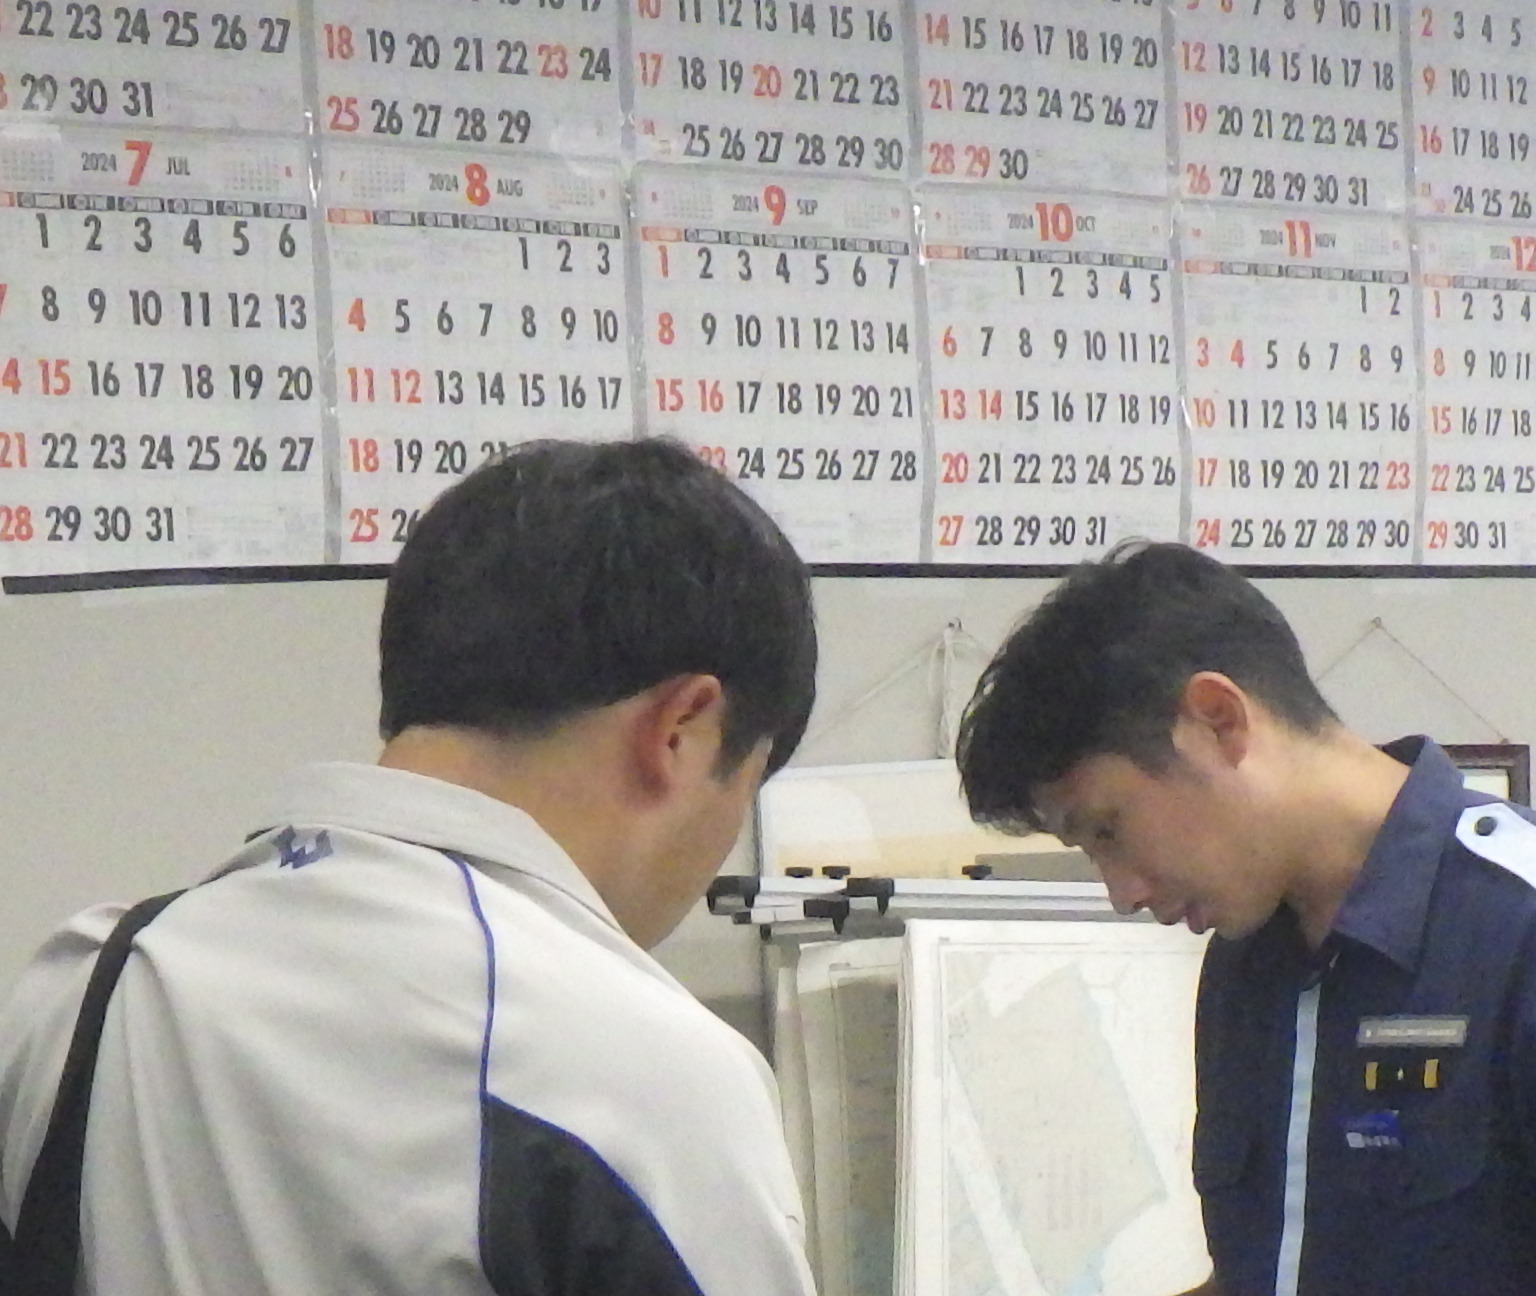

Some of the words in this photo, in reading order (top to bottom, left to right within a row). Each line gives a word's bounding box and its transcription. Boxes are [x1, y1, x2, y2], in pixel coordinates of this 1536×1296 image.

[324, 23, 354, 61] 18
[365, 27, 397, 65] 19
[405, 31, 442, 71] 20
[452, 35, 485, 73] 21
[495, 38, 530, 77] 22
[537, 43, 569, 80] 23
[577, 45, 613, 83] 24
[927, 78, 953, 111] 21
[961, 80, 990, 115] 22
[997, 82, 1029, 118] 23
[1036, 85, 1064, 120] 24
[1069, 90, 1096, 124] 25
[1100, 94, 1127, 128] 26
[1132, 97, 1160, 131] 27
[1183, 101, 1208, 132] 19
[1216, 104, 1245, 138] 20
[1251, 107, 1274, 140] 21
[1280, 111, 1306, 144] 22
[1311, 113, 1337, 146] 23
[1342, 116, 1369, 148] 24
[1374, 119, 1400, 151] 25
[81, 152, 117, 172] 2024
[123, 139, 154, 188] 7
[166, 156, 191, 176] JUL
[429, 173, 459, 191] 2024
[463, 162, 492, 208] 8
[497, 178, 524, 197] AUG
[762, 182, 788, 228] 9
[34, 211, 50, 250] 1
[82, 213, 104, 253] 2
[133, 215, 154, 254] 3
[182, 217, 204, 256] 4
[232, 219, 251, 258] 5
[277, 222, 297, 260] 6
[1033, 200, 1076, 244] 10
[1283, 218, 1315, 260] 11
[517, 235, 530, 272] 1
[555, 237, 574, 274] 2
[596, 241, 612, 277] 3
[1014, 264, 1026, 297] 1
[1049, 265, 1066, 299] 2
[1086, 267, 1100, 300] 3
[1117, 269, 1133, 302] 4
[1149, 272, 1162, 305] 5
[40, 284, 61, 323] 8
[86, 286, 108, 325] 9
[127, 288, 164, 328] 10
[179, 290, 212, 329] 11
[226, 291, 263, 330] 12
[274, 292, 308, 331] 13
[347, 297, 367, 334] 4
[394, 297, 412, 335] 5
[435, 299, 455, 337] 6
[477, 301, 494, 338] 7
[520, 303, 538, 340] 8
[559, 305, 578, 342] 9
[592, 307, 620, 345] 10
[941, 325, 958, 359] 6
[979, 325, 995, 358] 7
[1017, 326, 1034, 360] 8
[1052, 327, 1069, 361] 9
[1083, 329, 1108, 363] 10
[1117, 330, 1139, 364] 11
[1148, 332, 1171, 366] 12
[37, 357, 72, 397] 15
[86, 359, 122, 399] 16
[133, 361, 166, 399] 17
[180, 362, 216, 401] 18
[228, 362, 265, 402] 19
[276, 364, 314, 403] 20
[346, 366, 376, 403] 11
[390, 368, 423, 405] 12
[433, 368, 465, 407] 13
[475, 370, 507, 407] 14
[517, 372, 547, 409] 15
[557, 373, 588, 410] 16
[596, 375, 623, 411] 17
[939, 388, 968, 421] 13
[977, 388, 1003, 422] 14
[1014, 389, 1041, 423] 15
[1050, 390, 1076, 424] 16
[1084, 391, 1109, 424] 17
[1118, 392, 1141, 426] 18
[1148, 394, 1172, 427] 19
[40, 431, 80, 471] 22
[89, 432, 128, 471] 23
[138, 433, 176, 471] 24
[185, 434, 222, 473] 25
[232, 435, 269, 473] 26
[278, 435, 316, 473] 27
[348, 437, 381, 474] 18
[392, 437, 424, 475] 19
[433, 438, 468, 476] 20
[940, 451, 970, 485] 20
[976, 451, 1003, 485] 21
[1011, 451, 1043, 486] 22
[1050, 452, 1078, 486] 23
[1084, 453, 1113, 486] 24
[1118, 454, 1146, 487] 25
[1150, 455, 1177, 488] 26
[44, 504, 83, 543] 29
[92, 504, 133, 544] 30
[144, 505, 176, 544] 31
[348, 507, 380, 544] 25
[937, 514, 965, 548] 27
[973, 514, 1005, 548] 28
[1012, 514, 1042, 548] 29
[1047, 514, 1078, 547] 30
[1084, 514, 1108, 547] 31
[1196, 518, 1221, 548] 24
[1229, 517, 1255, 550] 25
[1261, 517, 1288, 550] 26
[1293, 517, 1319, 550] 27
[1325, 518, 1350, 550] 28
[1355, 518, 1378, 550] 29
[1383, 518, 1411, 550] 30
[1426, 520, 1449, 550] 29
[1453, 519, 1481, 550] 30
[1487, 520, 1508, 551] 31
